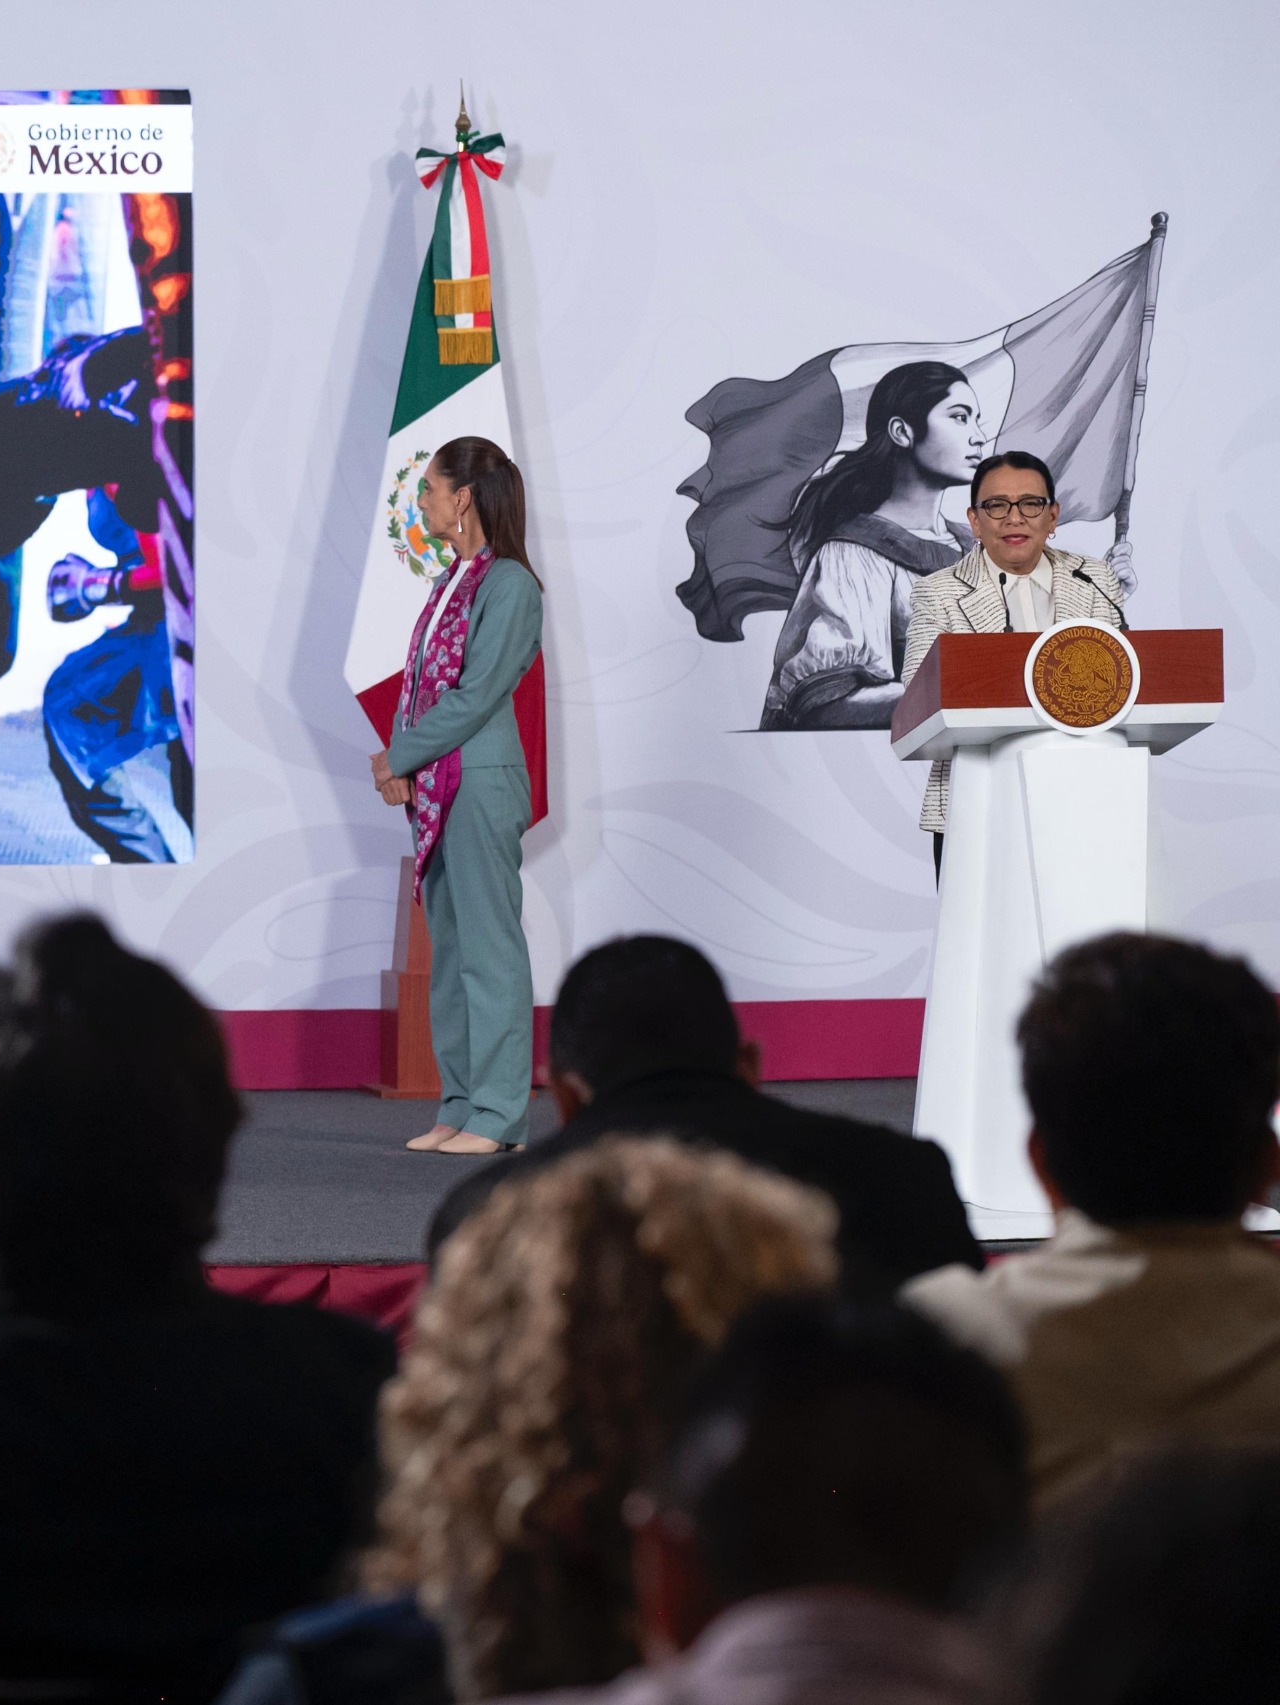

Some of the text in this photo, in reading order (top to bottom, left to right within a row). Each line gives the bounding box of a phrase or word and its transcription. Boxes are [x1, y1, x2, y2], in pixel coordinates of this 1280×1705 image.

[29, 124, 131, 140] Gobierno
[140, 124, 162, 140] de
[29, 145, 162, 175] México
[1035, 627, 1131, 677] ESTADOS UNIDOS MEXICANOS
